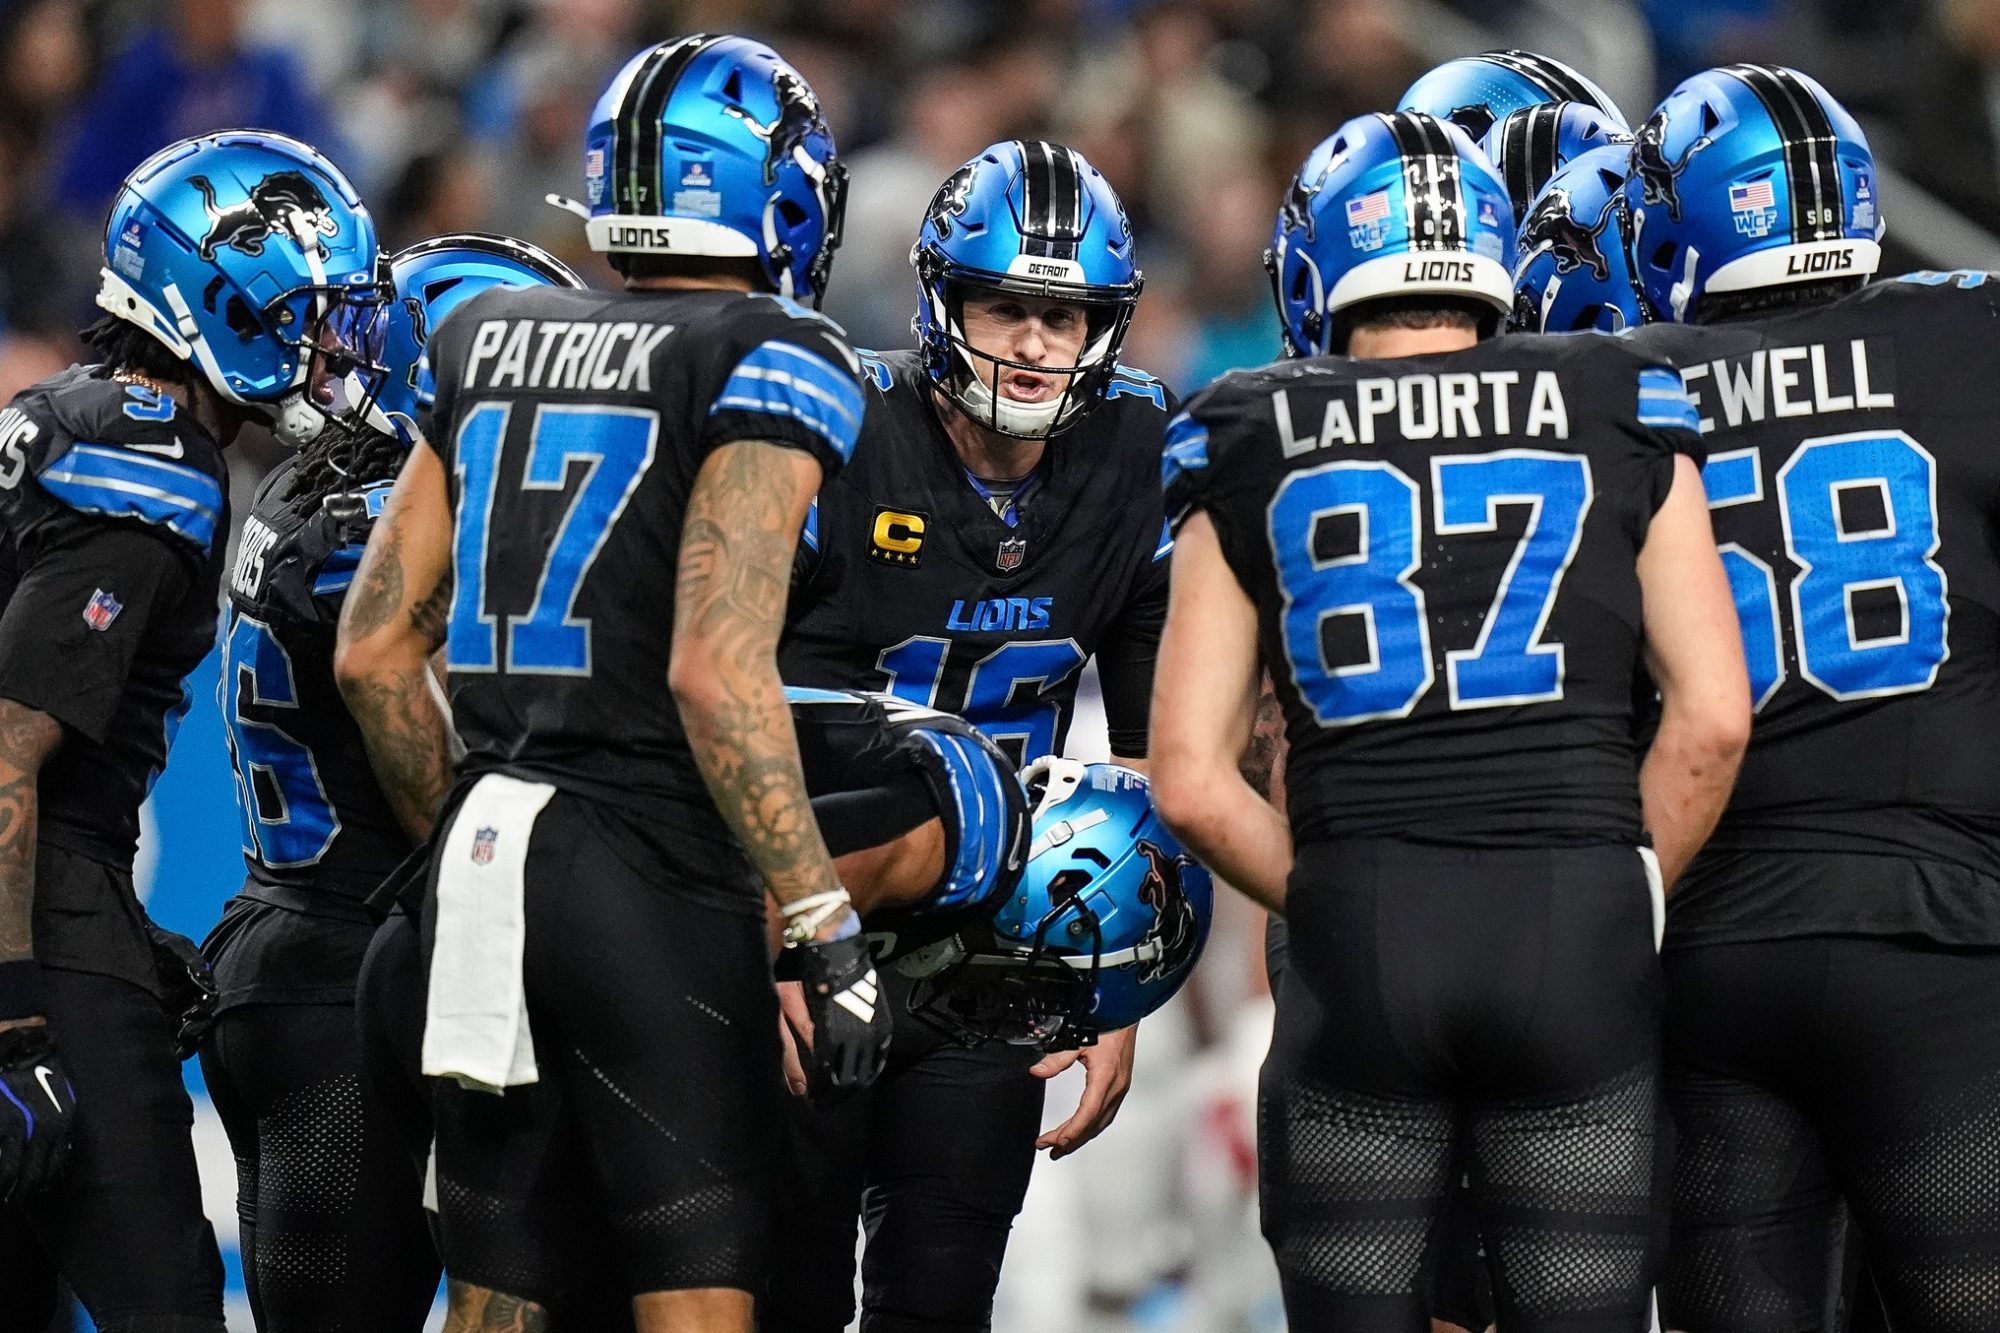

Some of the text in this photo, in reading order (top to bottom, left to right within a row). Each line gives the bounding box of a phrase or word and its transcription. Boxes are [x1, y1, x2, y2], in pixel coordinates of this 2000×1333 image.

[1806, 208, 1833, 226] 58
[608, 226, 671, 249] LIONS
[1028, 263, 1070, 278] DETROIT
[1404, 261, 1475, 283] LIONS
[1787, 248, 1854, 276] LIONS
[463, 319, 675, 392] PATRICK
[1681, 339, 1895, 434] EWELL
[446, 400, 661, 678] 17
[873, 510, 925, 552] C
[1266, 448, 1594, 728] 87
[945, 597, 1054, 632] LIONS
